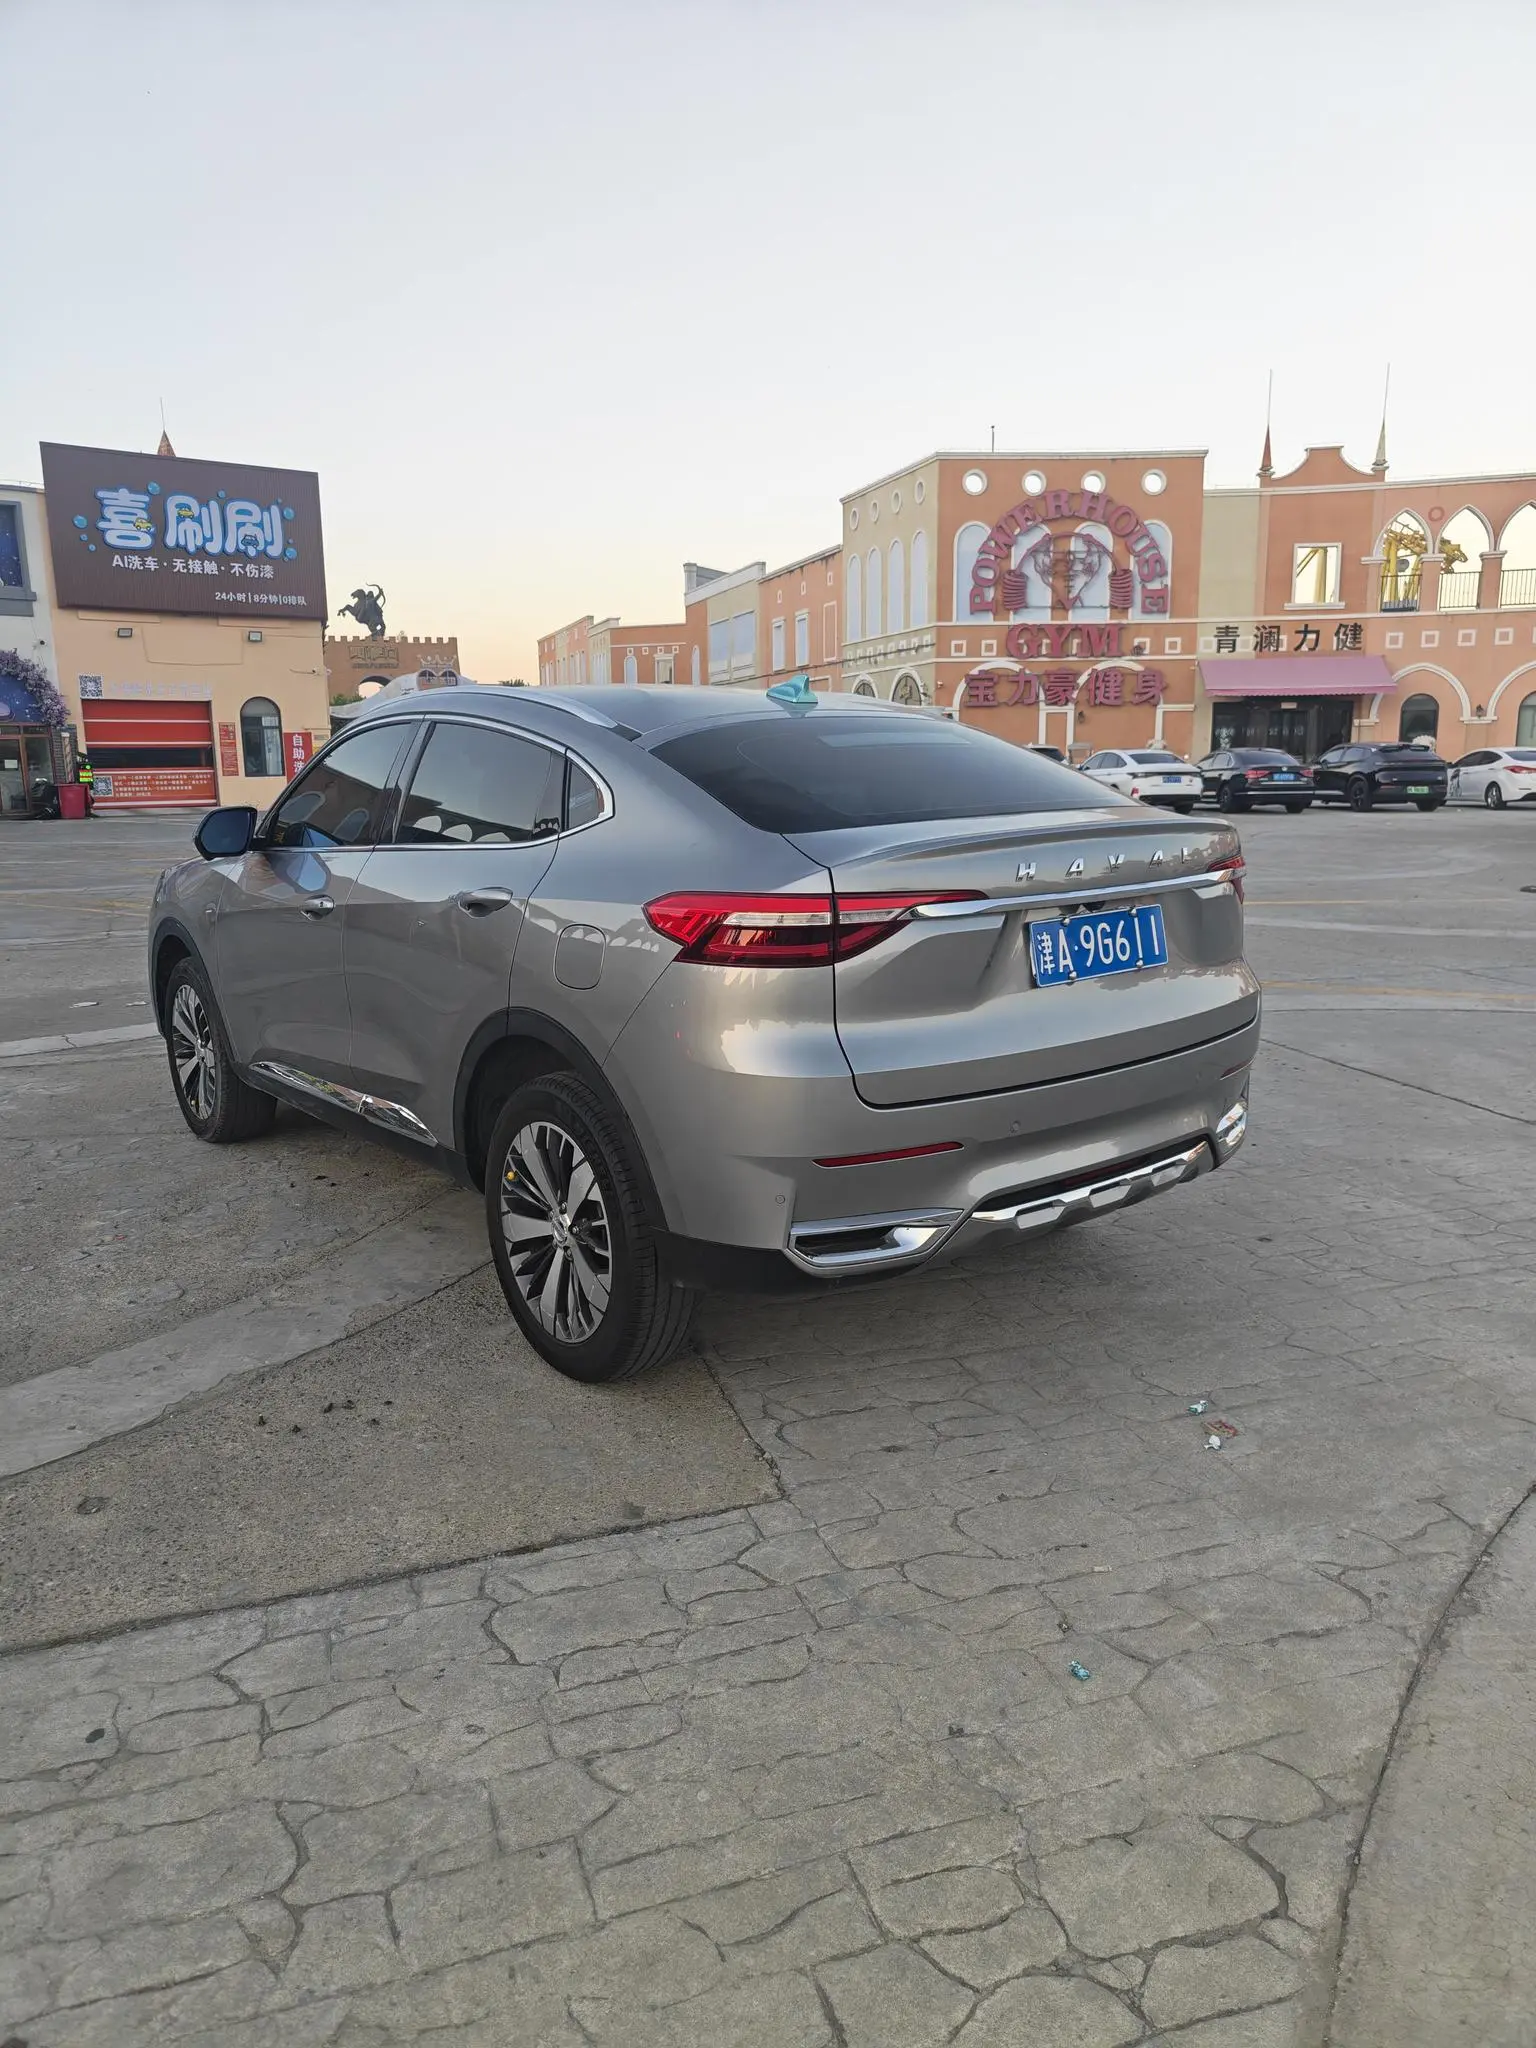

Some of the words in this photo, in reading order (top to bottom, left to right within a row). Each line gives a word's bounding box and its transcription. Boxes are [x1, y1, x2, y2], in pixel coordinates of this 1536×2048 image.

[95, 487, 284, 559] 喜刷刷
[969, 489, 1170, 615] POWERHOUSE
[1005, 623, 1125, 659] GYM
[965, 667, 1167, 708] 宝力豪健身
[1016, 847, 1189, 882] HAVAL
